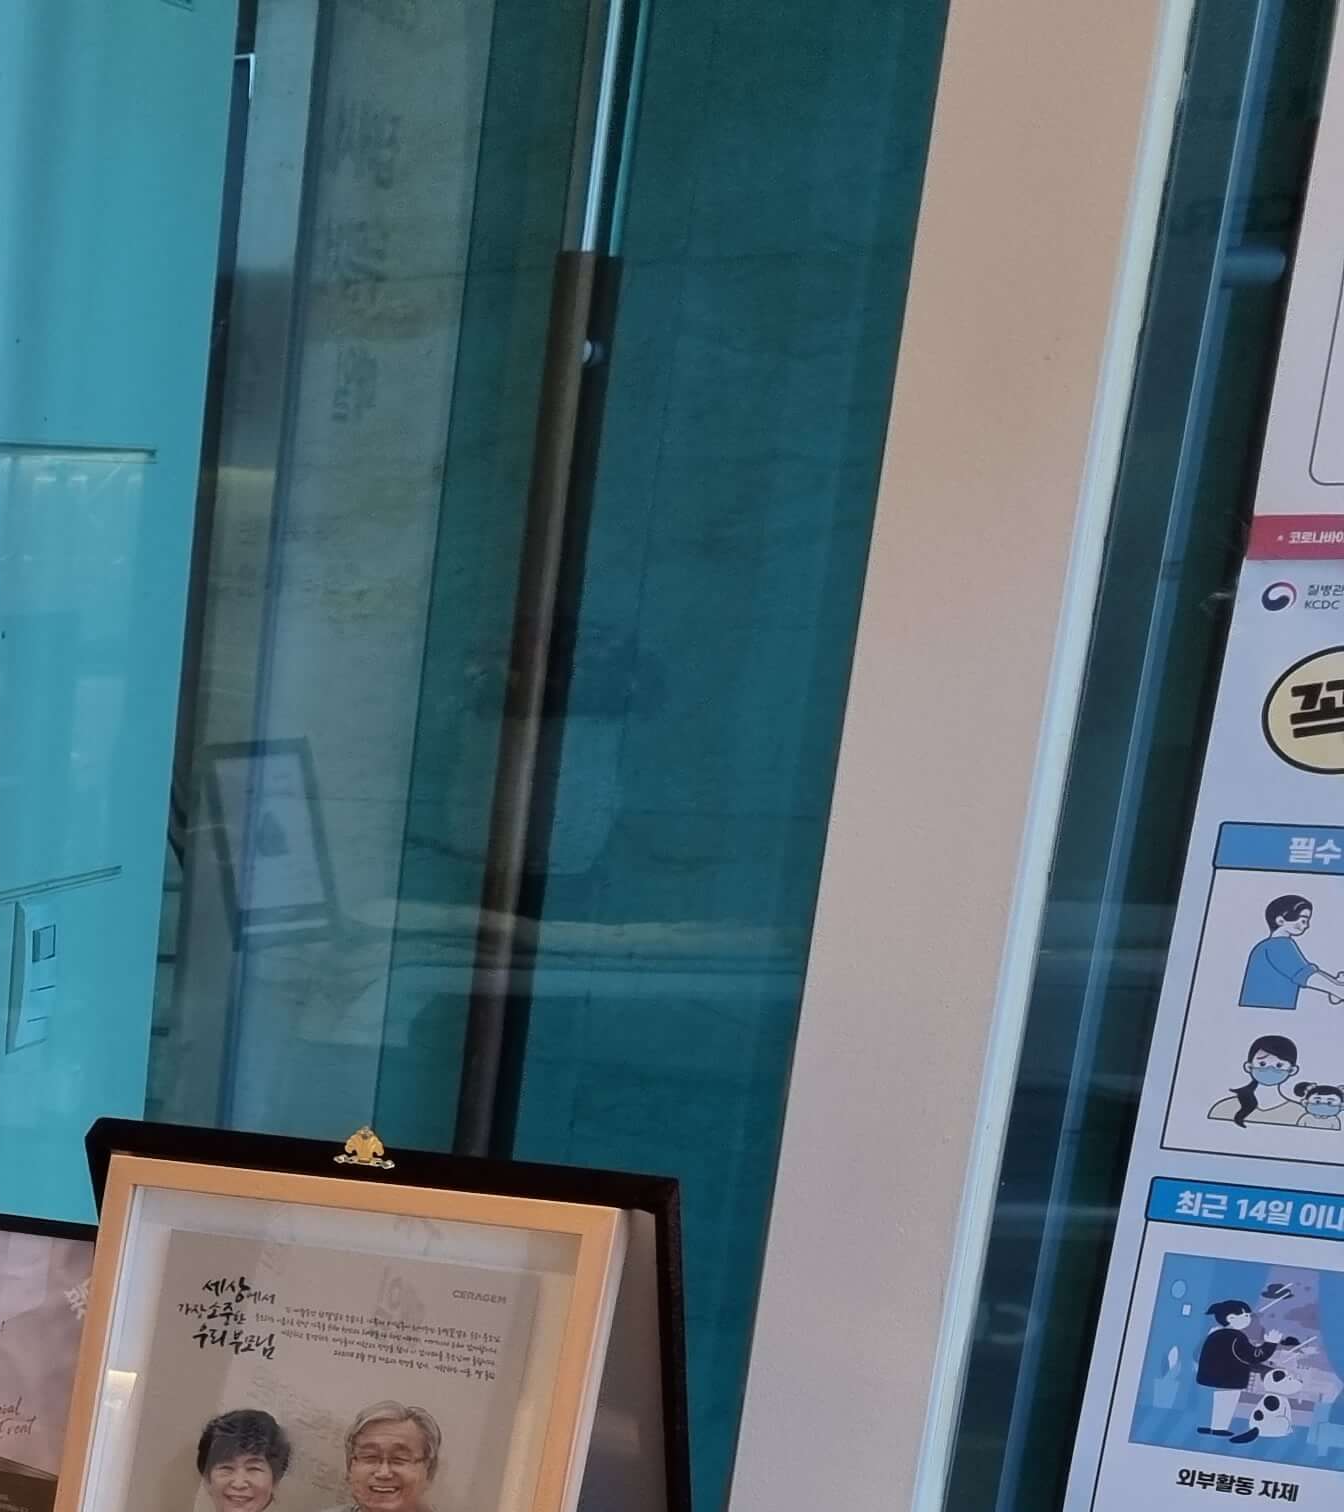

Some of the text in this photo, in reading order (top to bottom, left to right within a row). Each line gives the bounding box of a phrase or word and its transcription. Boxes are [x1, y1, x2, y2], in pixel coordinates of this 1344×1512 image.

[1304, 599, 1340, 610] KCDC
[1289, 837, 1343, 865] 필수
[1175, 1190, 1228, 1219] 최근
[1236, 1199, 1293, 1226] 14일
[202, 1276, 276, 1304] 세상에서
[452, 1289, 508, 1305] CERAGEM
[192, 1323, 227, 1349] 우리
[229, 1329, 275, 1360] 부모님
[1176, 1468, 1300, 1502] 외부활동 자제
